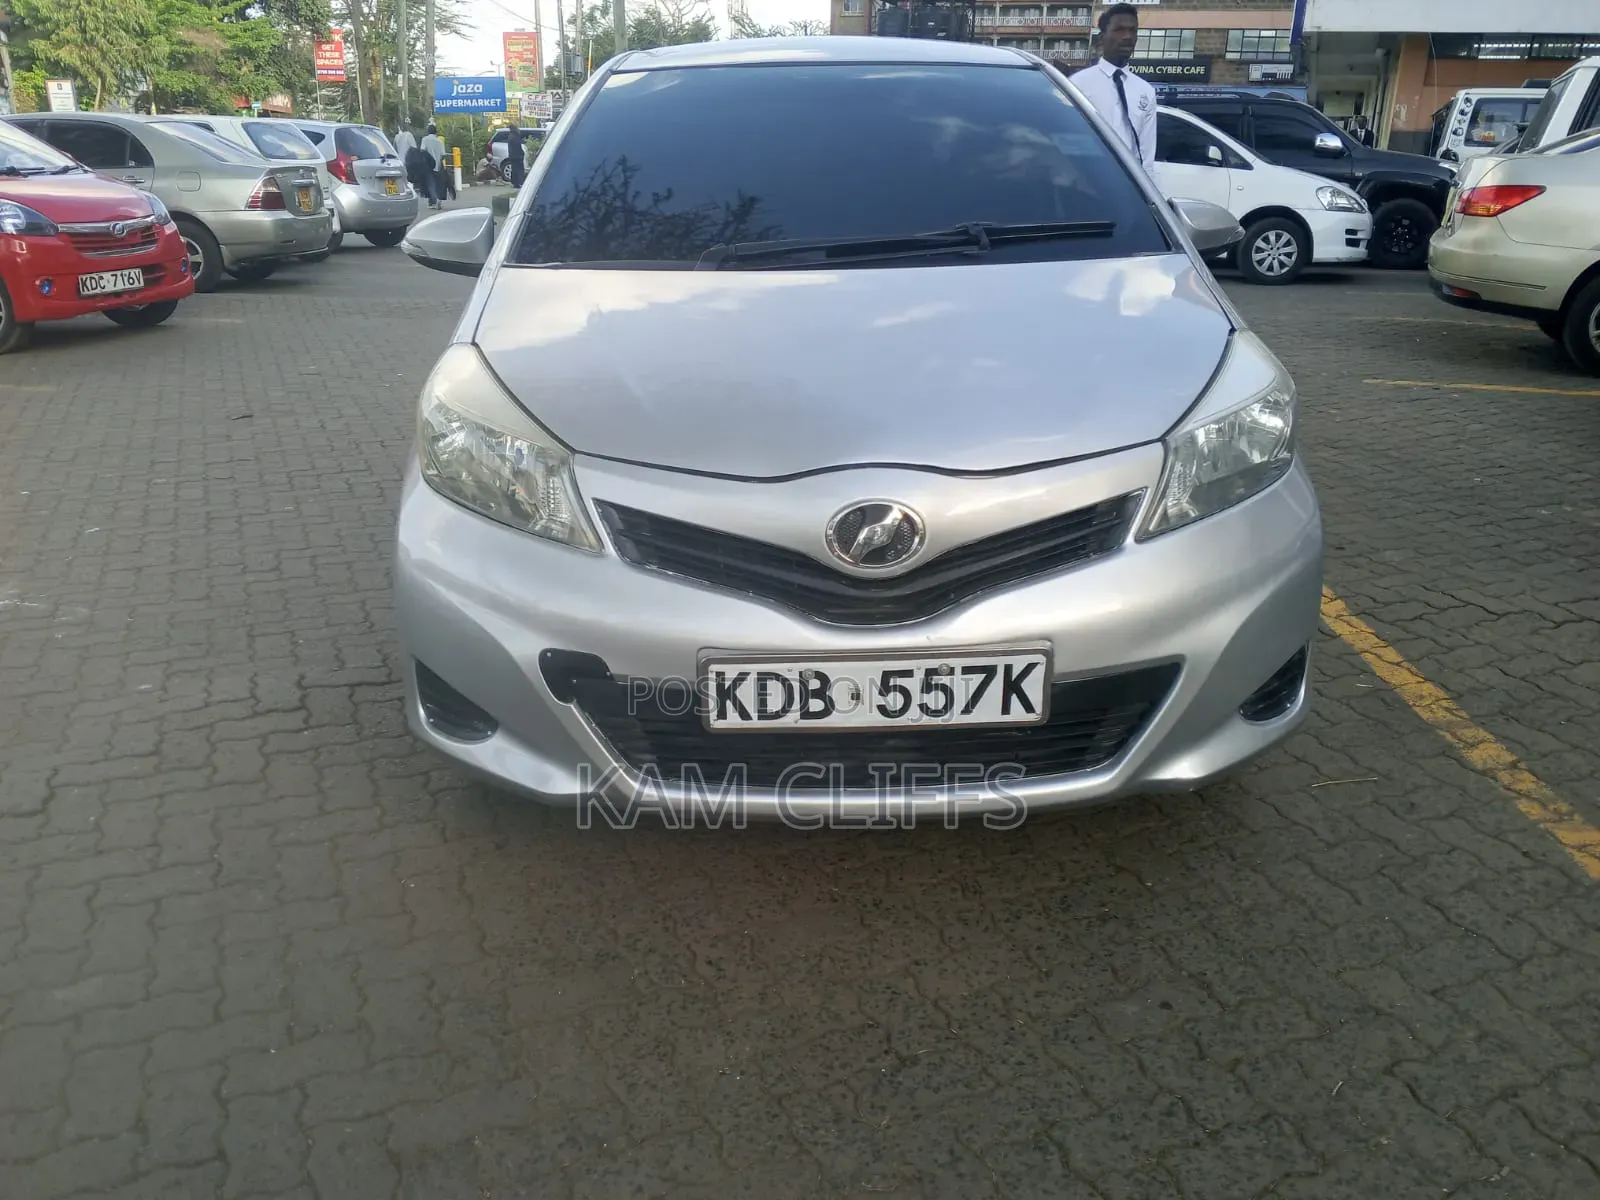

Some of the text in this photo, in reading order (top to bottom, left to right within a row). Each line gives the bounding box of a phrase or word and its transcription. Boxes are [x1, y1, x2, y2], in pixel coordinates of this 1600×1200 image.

[1156, 66, 1182, 74] CYBER
[1184, 66, 1206, 74] CAFE
[451, 79, 483, 97] jaza
[434, 98, 502, 108] SUPERMARKET
[80, 270, 141, 293] KDC 716V
[714, 661, 1041, 721] KDB 557K
